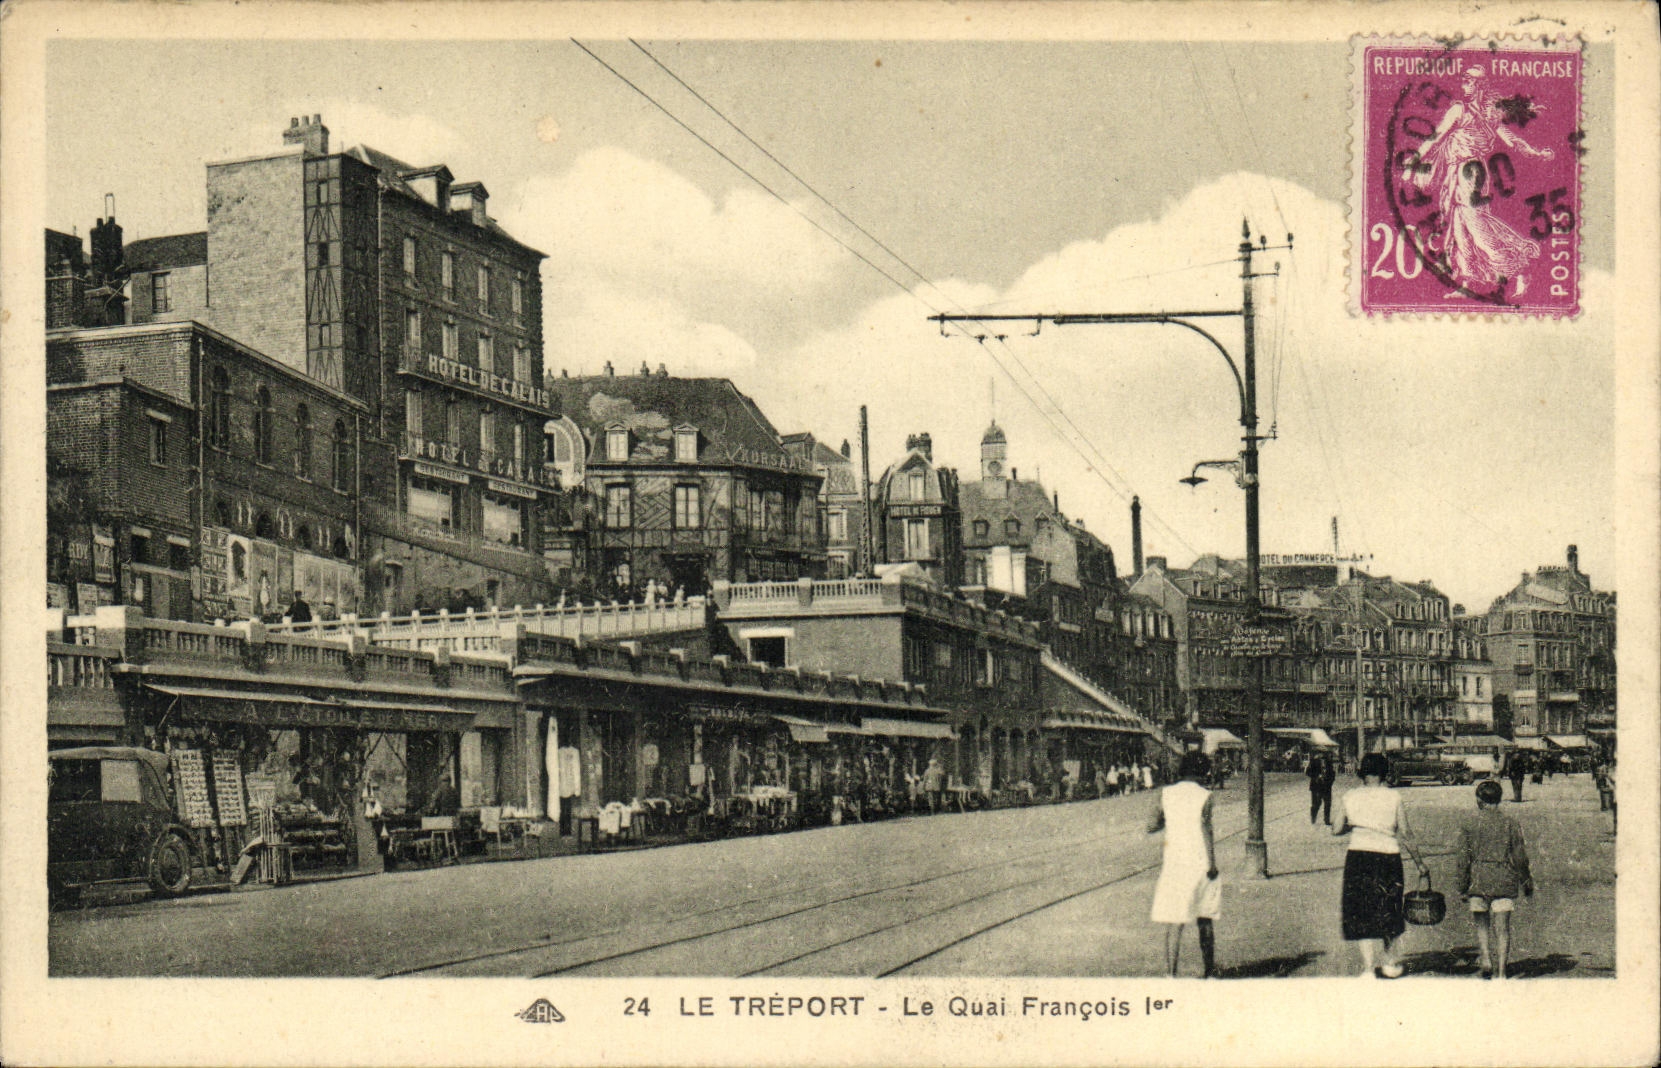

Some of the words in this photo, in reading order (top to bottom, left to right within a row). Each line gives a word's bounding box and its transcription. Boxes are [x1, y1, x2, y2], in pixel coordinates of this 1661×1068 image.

[1492, 59, 1573, 79] FRANÇAISE
[1462, 152, 1515, 208] 20
[1551, 210, 1570, 297] POSTES
[428, 353, 478, 386] HOTEL
[480, 370, 498, 393] DE
[501, 378, 550, 409] CALAIS
[741, 449, 809, 470] KURSAAL
[1258, 553, 1280, 565] OTEL
[1282, 554, 1293, 564] DU
[1294, 553, 1335, 564] COMMERCE
